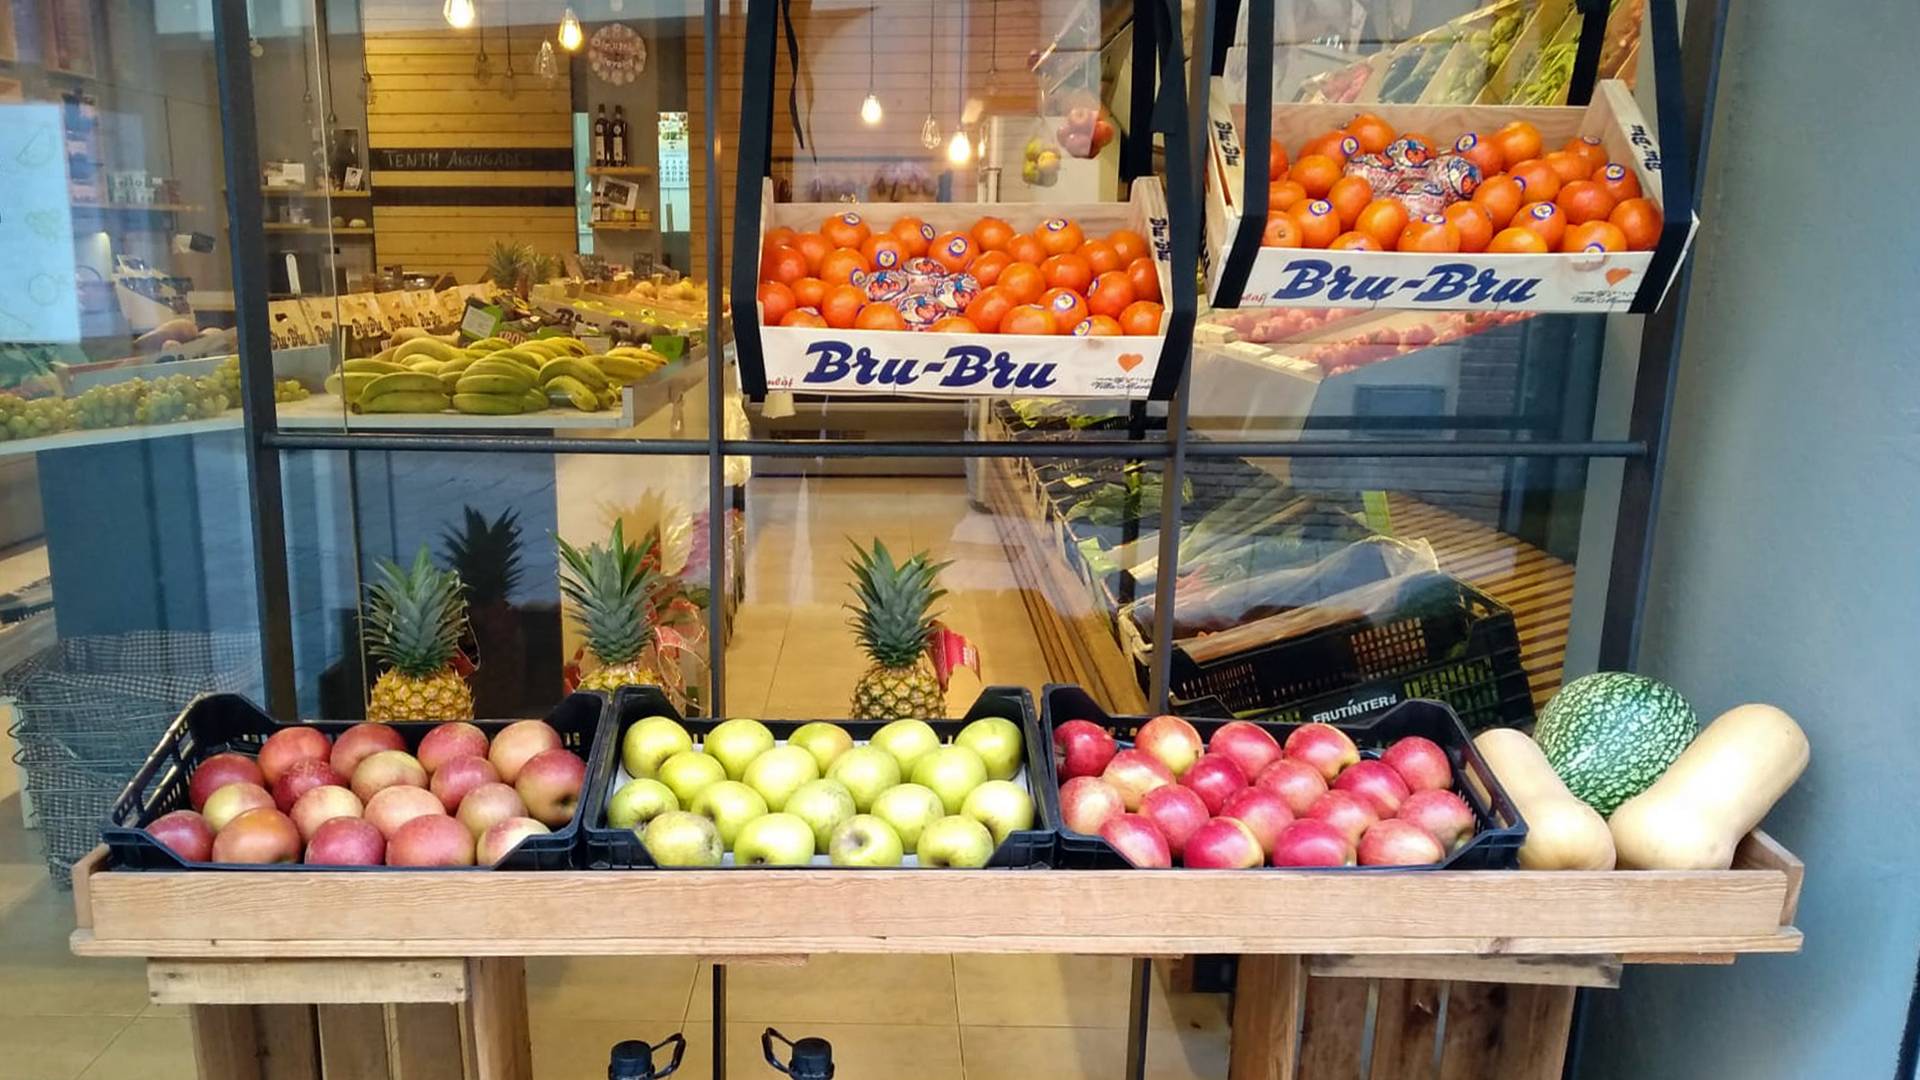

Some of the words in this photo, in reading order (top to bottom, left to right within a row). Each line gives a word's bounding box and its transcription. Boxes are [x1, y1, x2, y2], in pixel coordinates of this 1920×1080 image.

[384, 150, 439, 168] TENIM
[1272, 259, 1541, 303] Bru-Bru
[803, 341, 1058, 389] Bru-Bru
